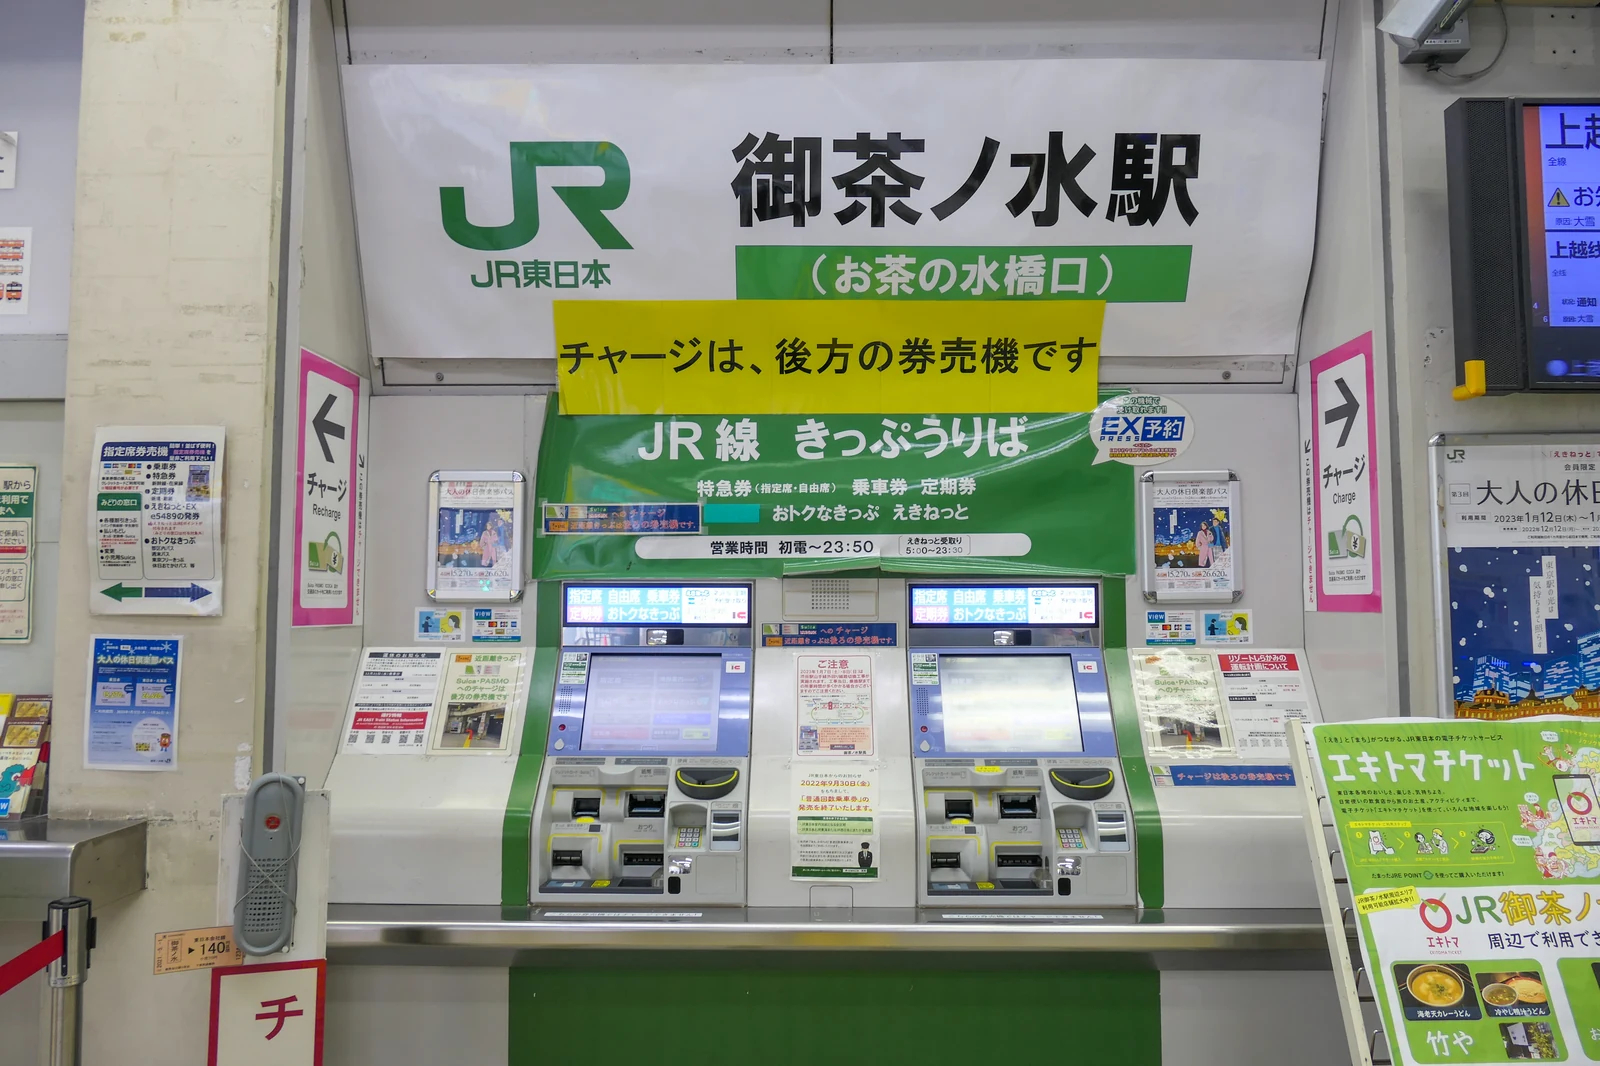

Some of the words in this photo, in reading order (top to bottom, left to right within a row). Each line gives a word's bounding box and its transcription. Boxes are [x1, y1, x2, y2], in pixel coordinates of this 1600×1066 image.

[1548, 156, 1567, 167] 全線
[731, 131, 1201, 227] 御茶ノ水駅
[439, 141, 634, 251] JR
[1573, 187, 1600, 207] お
[1574, 216, 1596, 227] 大雪
[471, 259, 611, 289] JR東日本
[1577, 297, 1597, 307] 通知
[1577, 315, 1594, 323] 大雪
[560, 337, 1097, 375] チャージは、後方の券売機です
[1101, 417, 1142, 435] EX
[1145, 419, 1183, 439] 予約
[638, 418, 760, 462] JR線
[794, 416, 1029, 460] きっぷうりば
[103, 446, 169, 457] 指定席券売機
[1446, 449, 1466, 460] JR
[153, 463, 177, 471] 乗車券
[1323, 454, 1366, 488] チャージ
[1564, 463, 1596, 471] 会員限定
[152, 472, 176, 480] 特急券
[3, 480, 32, 490] 駅から
[151, 487, 175, 495] 定期券
[307, 473, 347, 502] チャージ
[852, 478, 908, 496] 乗車券
[921, 478, 976, 496] 定期券
[1157, 488, 1228, 496] 大人の休日倶楽部パス
[1332, 491, 1356, 505] Charge
[100, 498, 138, 506] みどりの窓口
[151, 512, 200, 520] e5489の発券
[312, 503, 341, 520] Recharge
[772, 504, 879, 522] おトクなきっぷ
[893, 504, 969, 521] えきねっと
[151, 537, 196, 545] おトクなきっぷ
[710, 540, 768, 554] 営業時間
[907, 536, 963, 545] えきねっと受取り
[569, 590, 603, 604] 指定席
[608, 590, 641, 604] 自由席
[647, 590, 680, 604] 乗車券
[914, 590, 948, 604] 指定席
[953, 590, 987, 604] 自由席
[993, 590, 1026, 604] 乗車券
[569, 606, 603, 621] 定期券
[608, 606, 680, 621] おトクなきっぷ
[914, 606, 948, 621] 定期券
[953, 606, 1026, 621] おトクなきっぷ
[818, 659, 849, 669] ご注意
[1228, 654, 1287, 662] リゾートしらかみの
[1230, 663, 1289, 671] 運転計画について
[450, 693, 509, 701] 後方の券売機です
[1328, 749, 1535, 783] エキトマチケット
[1177, 772, 1291, 781] チャージは後ろの券売機です
[1572, 817, 1597, 825] エキトマ
[1456, 890, 1600, 926] JR御茶ノ
[200, 941, 226, 955] 140
[1426, 936, 1459, 948] エキトマ
[171, 940, 179, 962] 御茶ノ水
[255, 995, 303, 1041] チ
[1417, 1009, 1470, 1018] 海老天カレーうどん
[1426, 1030, 1474, 1057] 竹や
